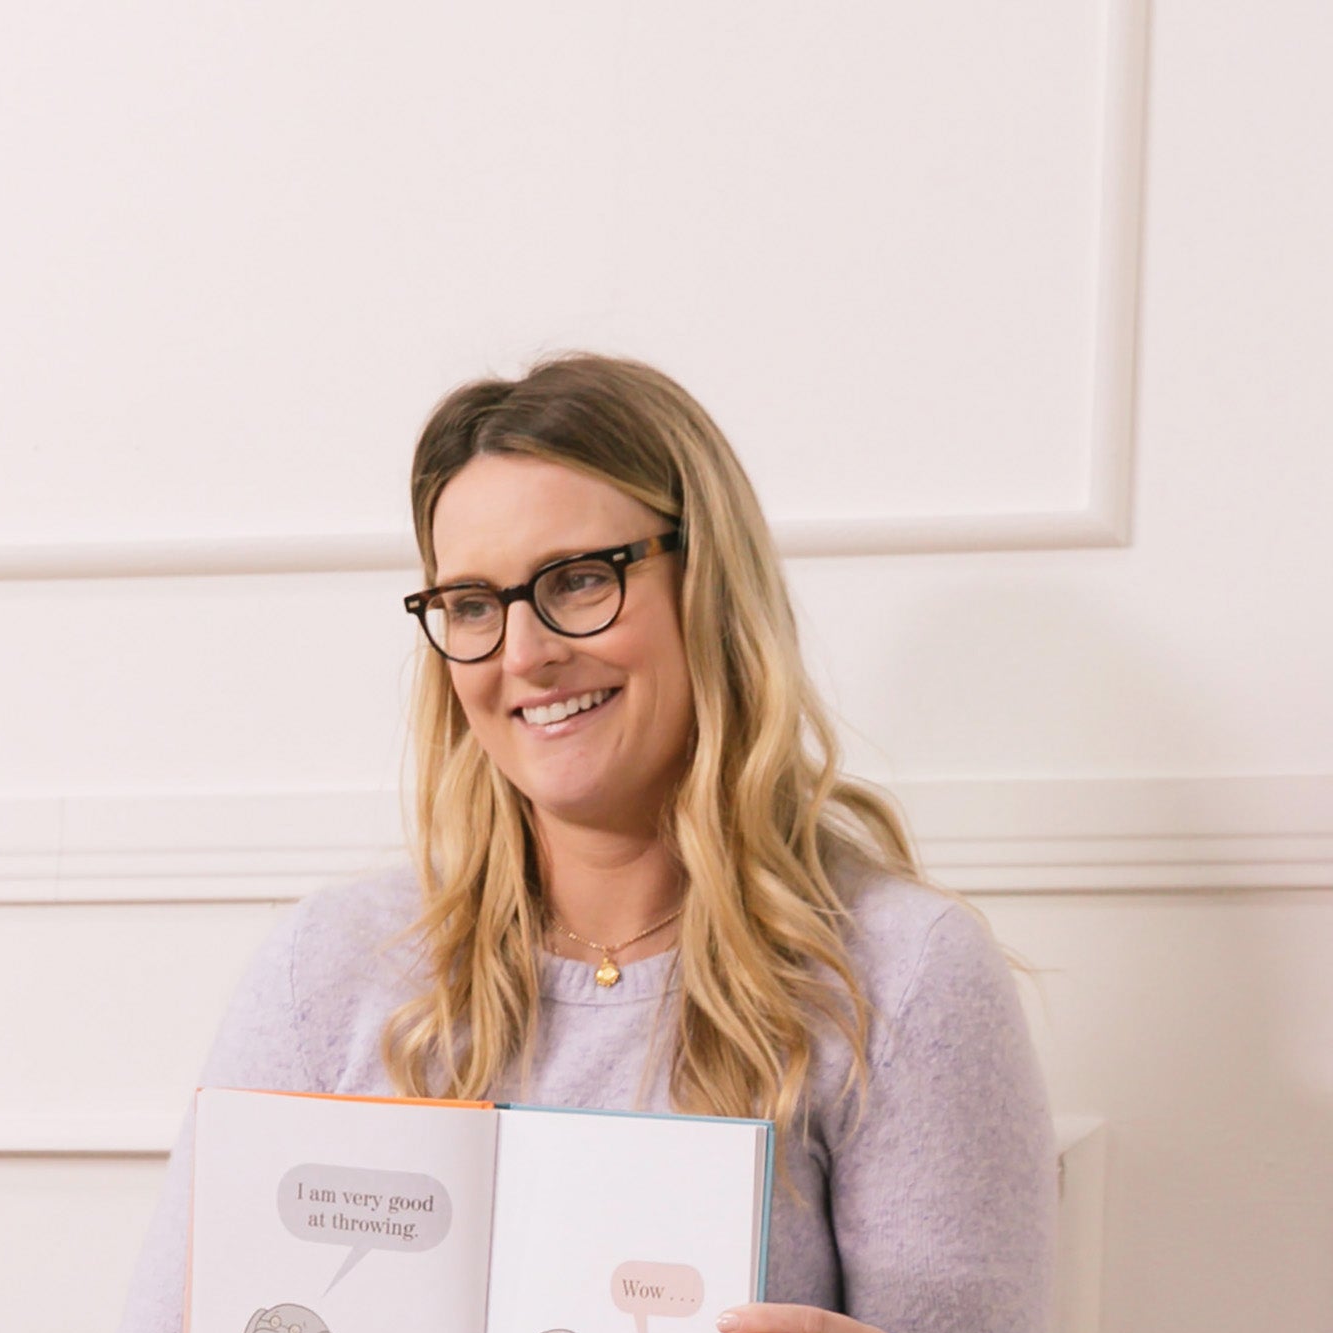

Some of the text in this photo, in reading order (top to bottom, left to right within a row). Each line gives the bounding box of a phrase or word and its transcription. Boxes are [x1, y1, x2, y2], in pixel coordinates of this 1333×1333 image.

[297, 1182, 434, 1213] I am very good
[308, 1212, 418, 1240] at throwing.
